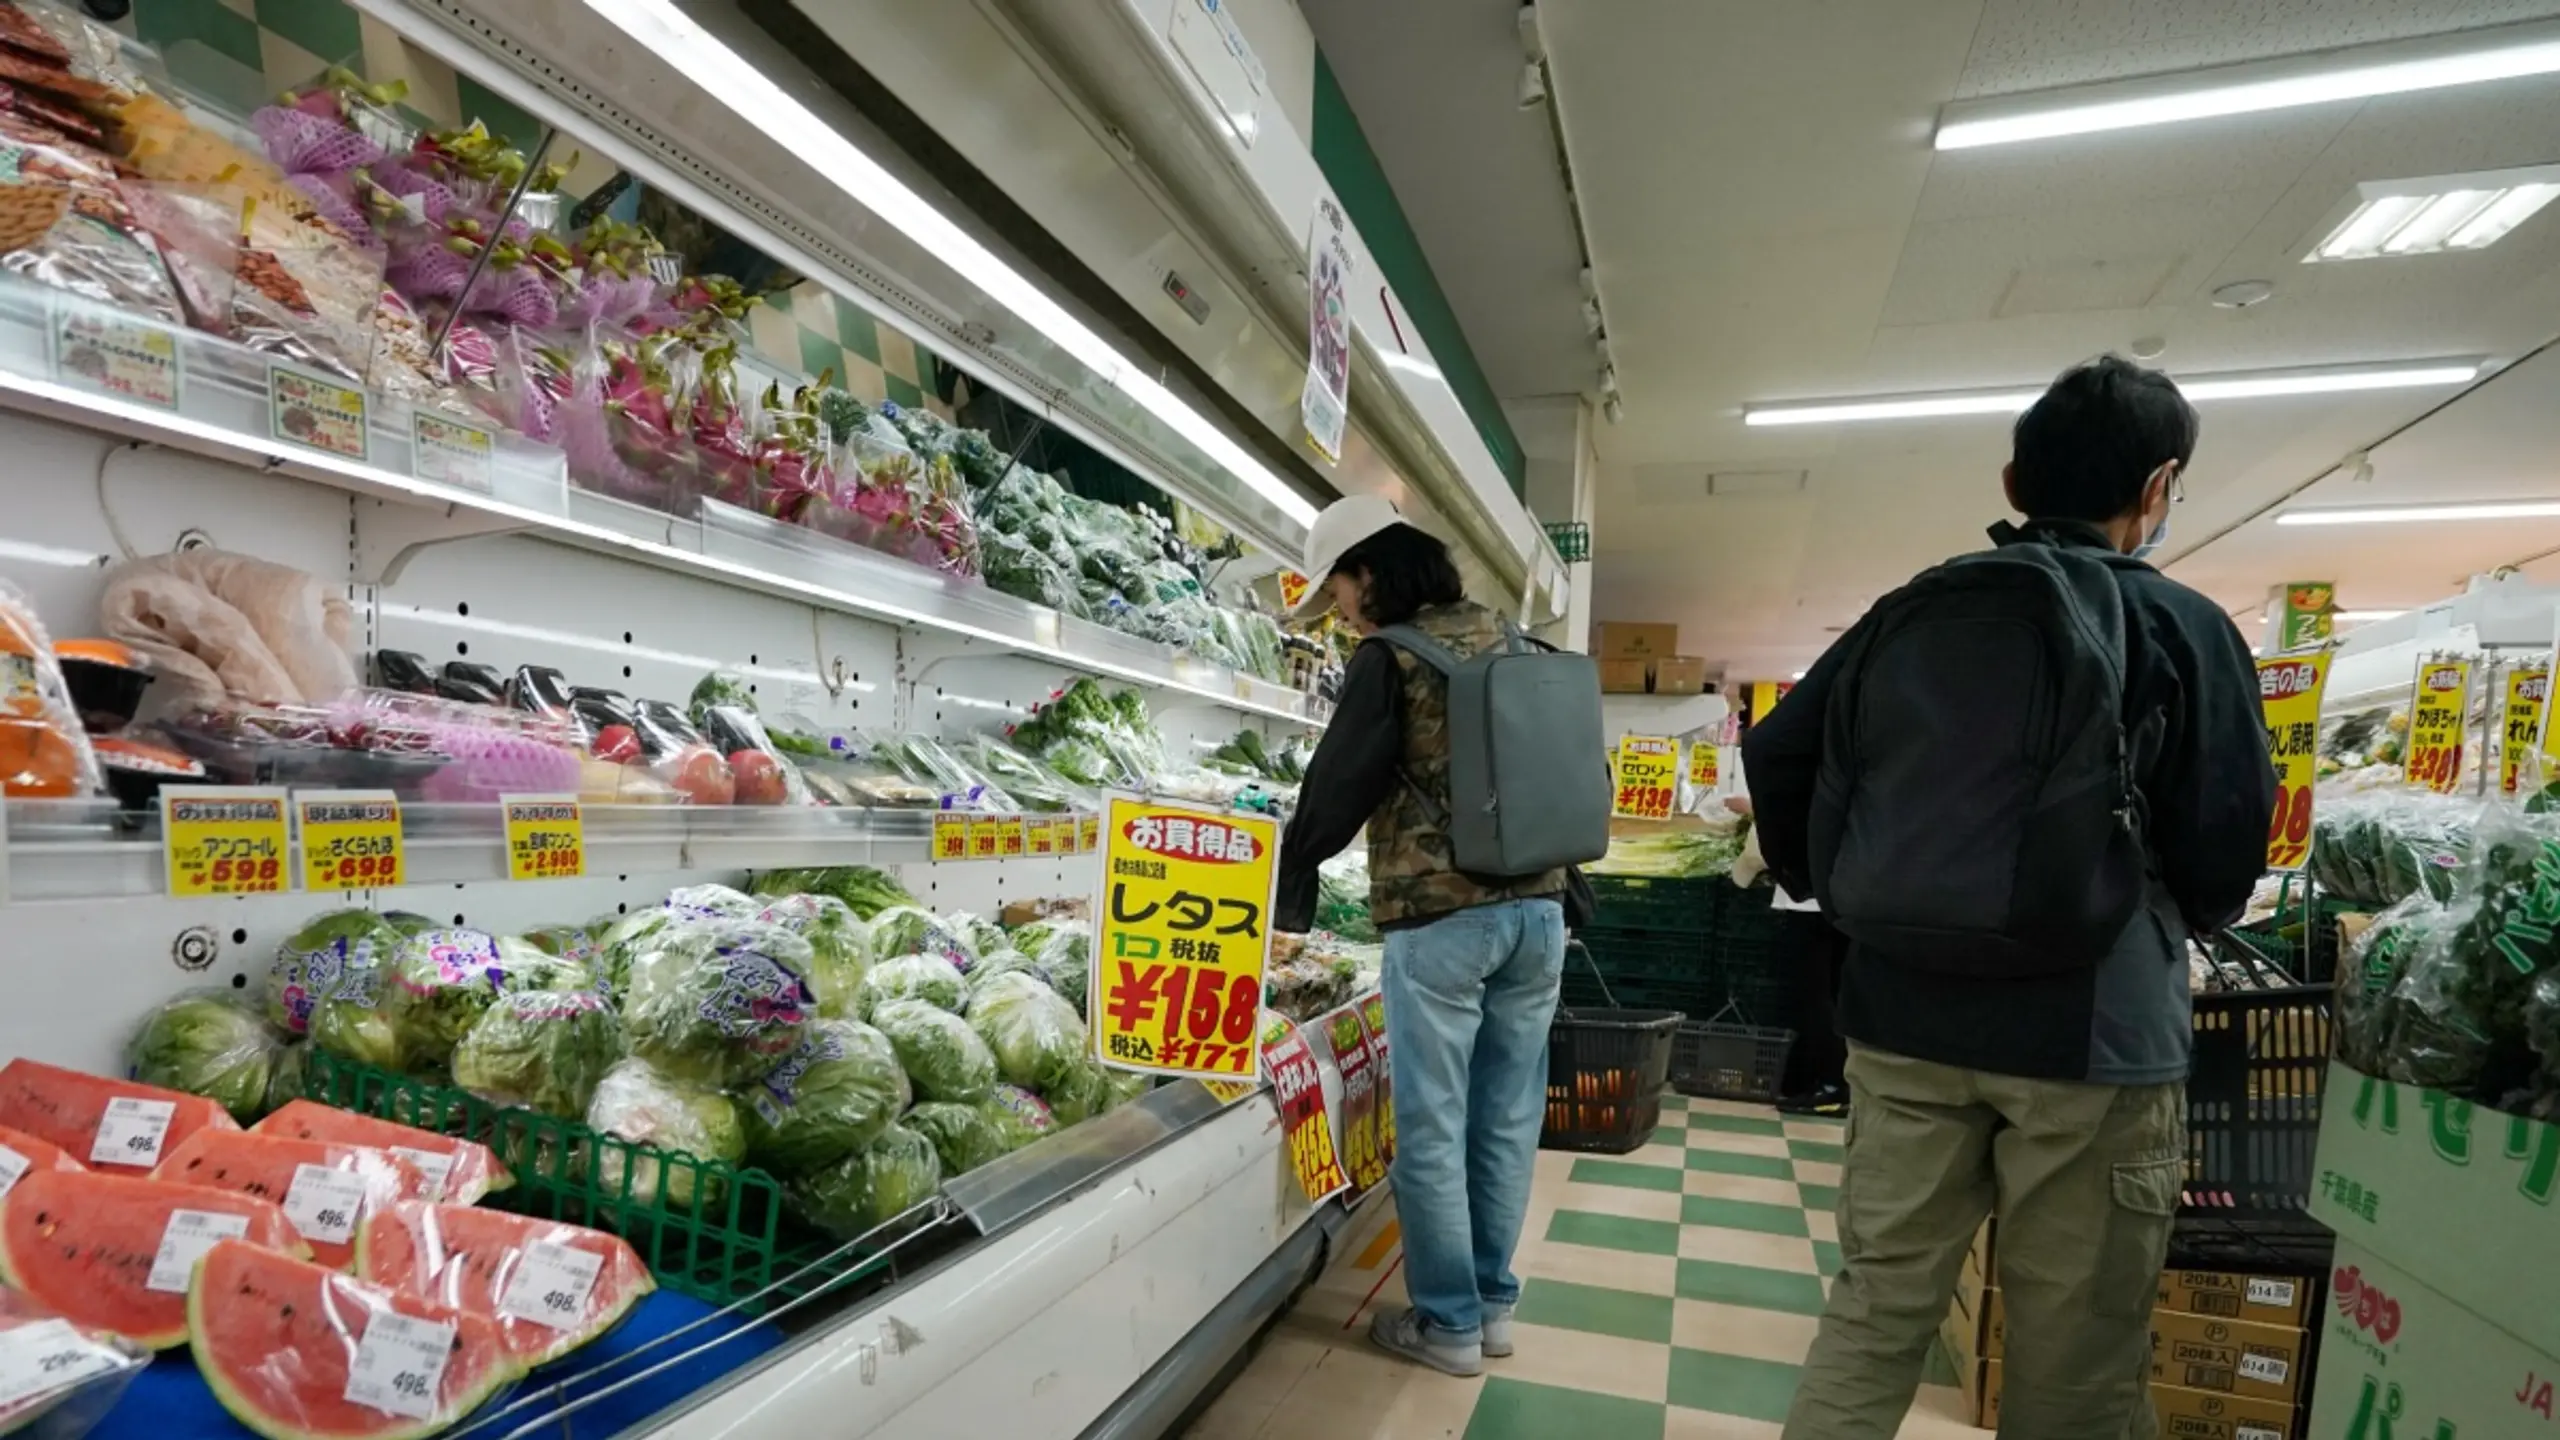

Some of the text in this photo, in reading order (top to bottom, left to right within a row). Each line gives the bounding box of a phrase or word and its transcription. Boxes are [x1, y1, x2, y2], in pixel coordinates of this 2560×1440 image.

[2257, 667, 2314, 695] 告の品
[2266, 722, 2313, 757] めじ徳用
[2508, 719, 2538, 742] れん
[1623, 763, 1673, 778] セロリー
[2269, 785, 2312, 843] 08
[202, 836, 278, 858] アンコール
[331, 836, 394, 857] さくらんぼ
[1130, 816, 1255, 863] お買得品
[2268, 845, 2305, 865] 17
[1111, 882, 1260, 939] レタス
[1112, 932, 1221, 963] 1コ 税抜
[1107, 960, 1260, 1044] ¥158
[1109, 1033, 1153, 1061] 税込
[1157, 1038, 1250, 1072] ¥171
[2321, 1170, 2379, 1225] 千葉県産
[316, 1209, 345, 1227] 498
[543, 1290, 576, 1312] 498
[2250, 1284, 2271, 1297] 614
[2241, 1361, 2265, 1374] 614
[392, 1370, 428, 1397] 498
[2515, 1371, 2555, 1420] JA
